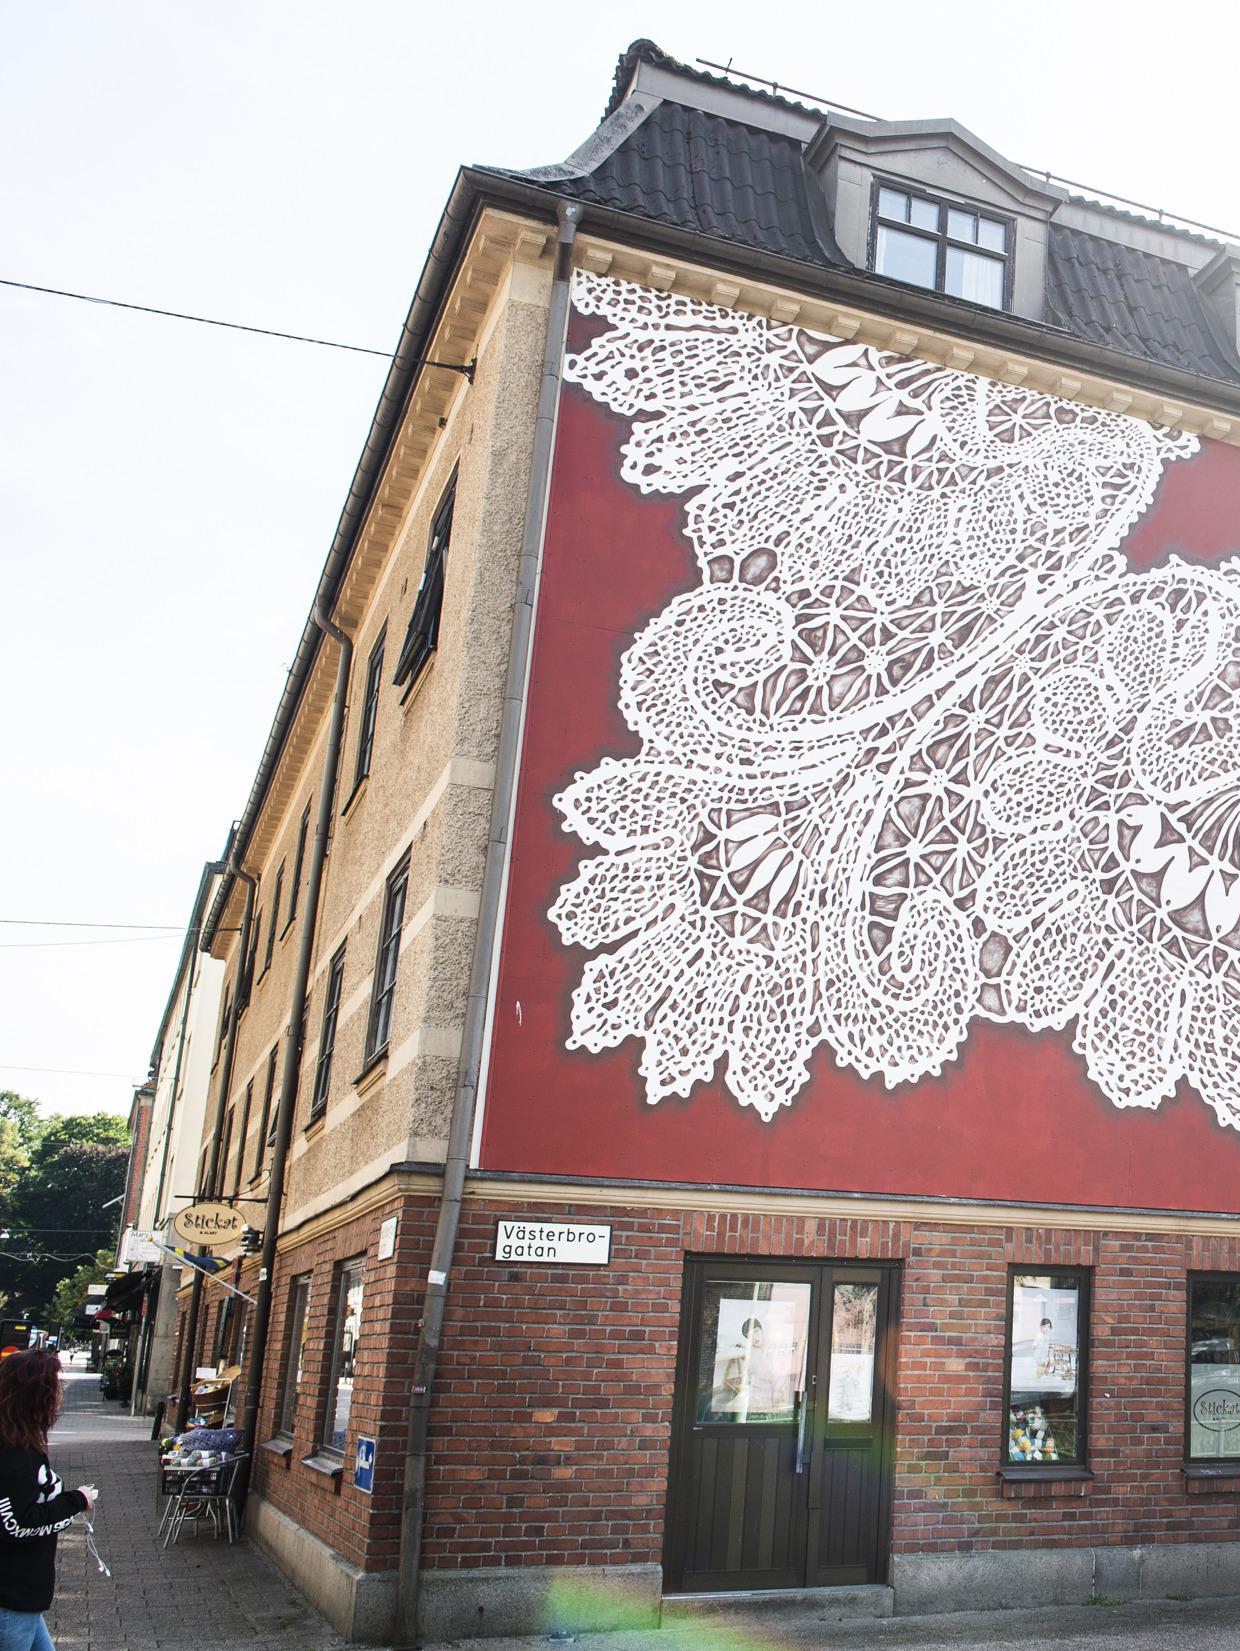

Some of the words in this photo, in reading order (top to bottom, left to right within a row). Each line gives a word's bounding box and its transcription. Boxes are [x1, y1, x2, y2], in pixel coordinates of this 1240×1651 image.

[184, 1213, 238, 1230] Stickat
[504, 1225, 605, 1243] Västerbro-
[502, 1243, 556, 1259] gatan
[1200, 1400, 1240, 1416] Stickat
